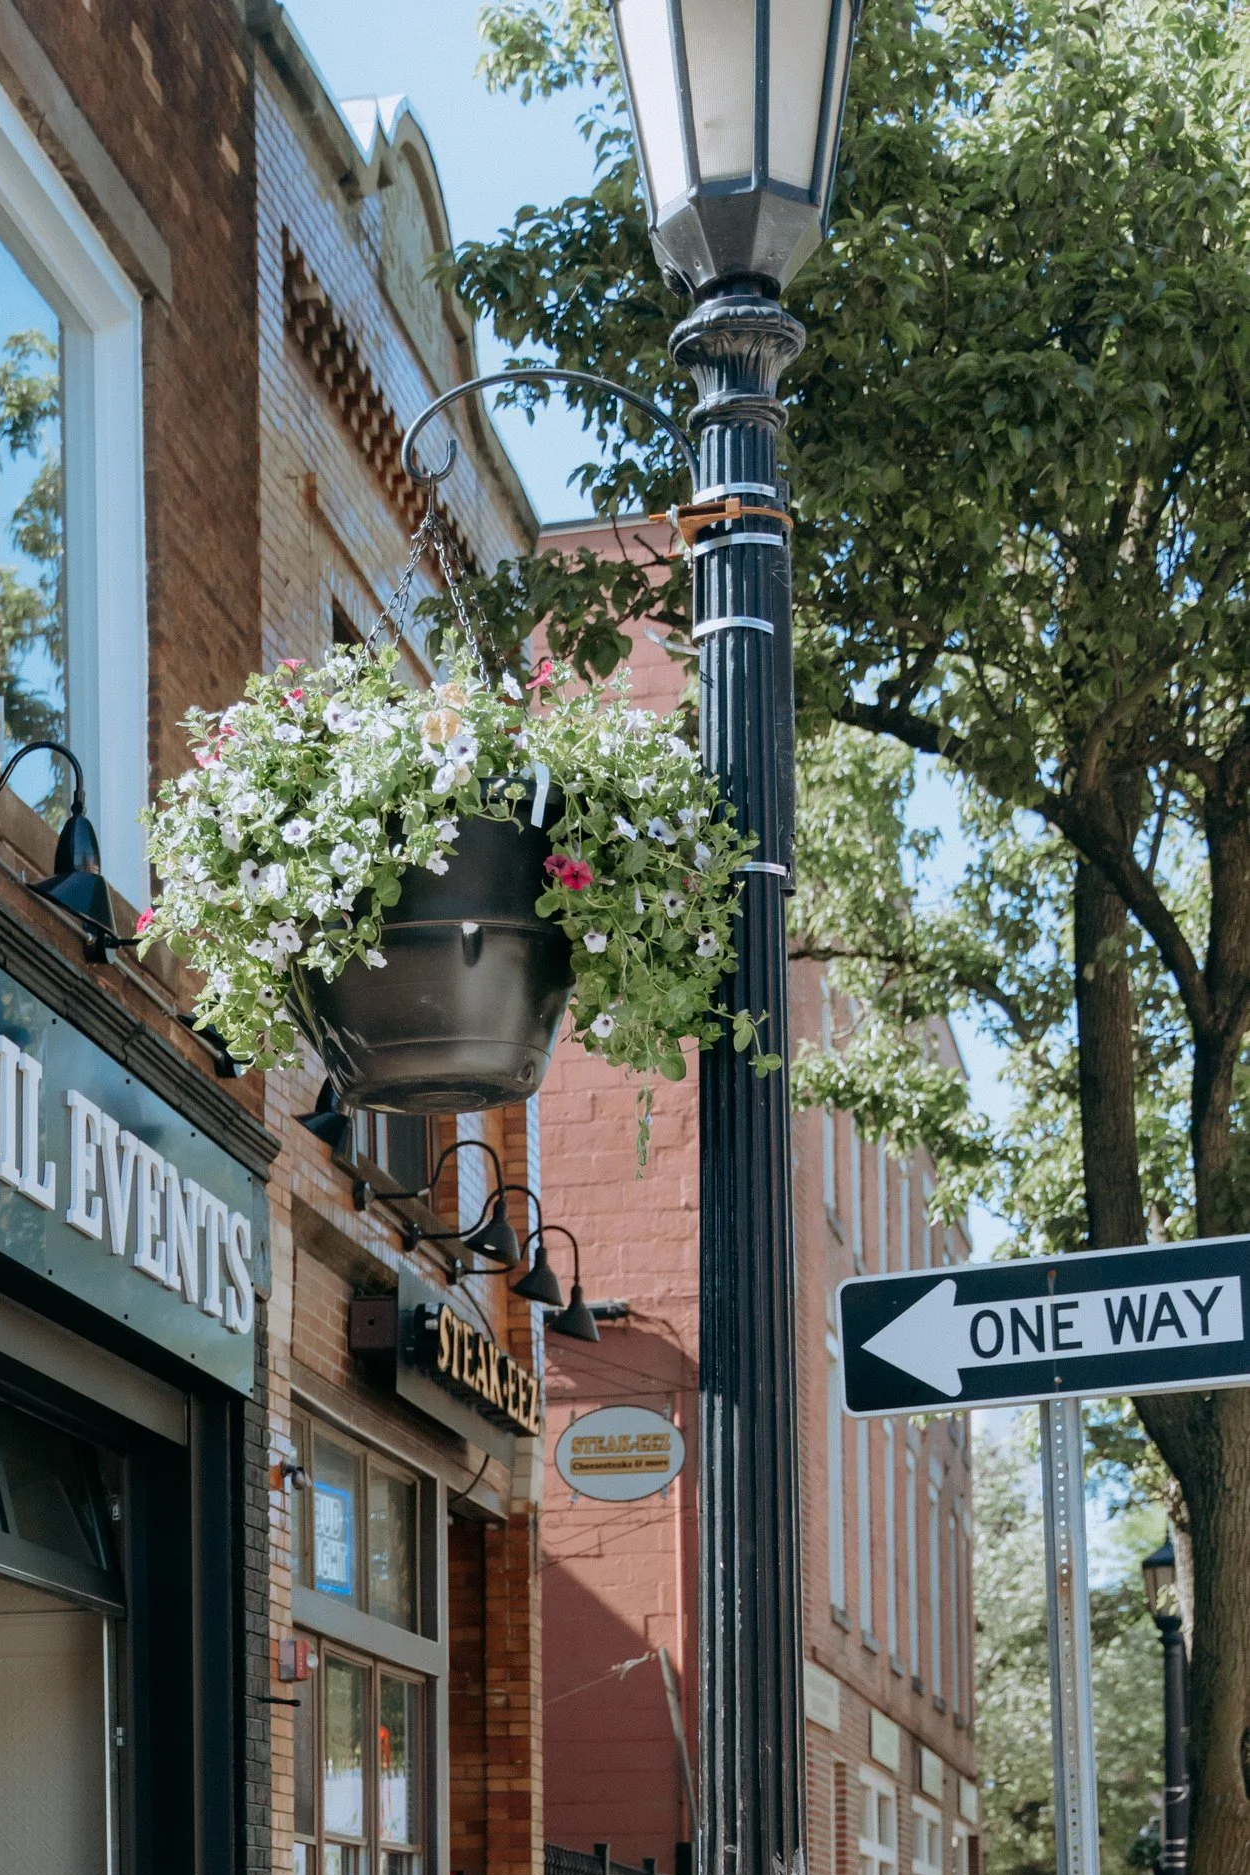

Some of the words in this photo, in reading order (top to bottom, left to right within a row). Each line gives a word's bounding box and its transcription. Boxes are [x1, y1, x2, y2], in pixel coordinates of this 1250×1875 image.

[66, 1088, 254, 1335] EVENTS
[969, 1300, 1083, 1360] ONE
[1104, 1285, 1224, 1346] WAY
[571, 1432, 671, 1455] STEAK-EEZ
